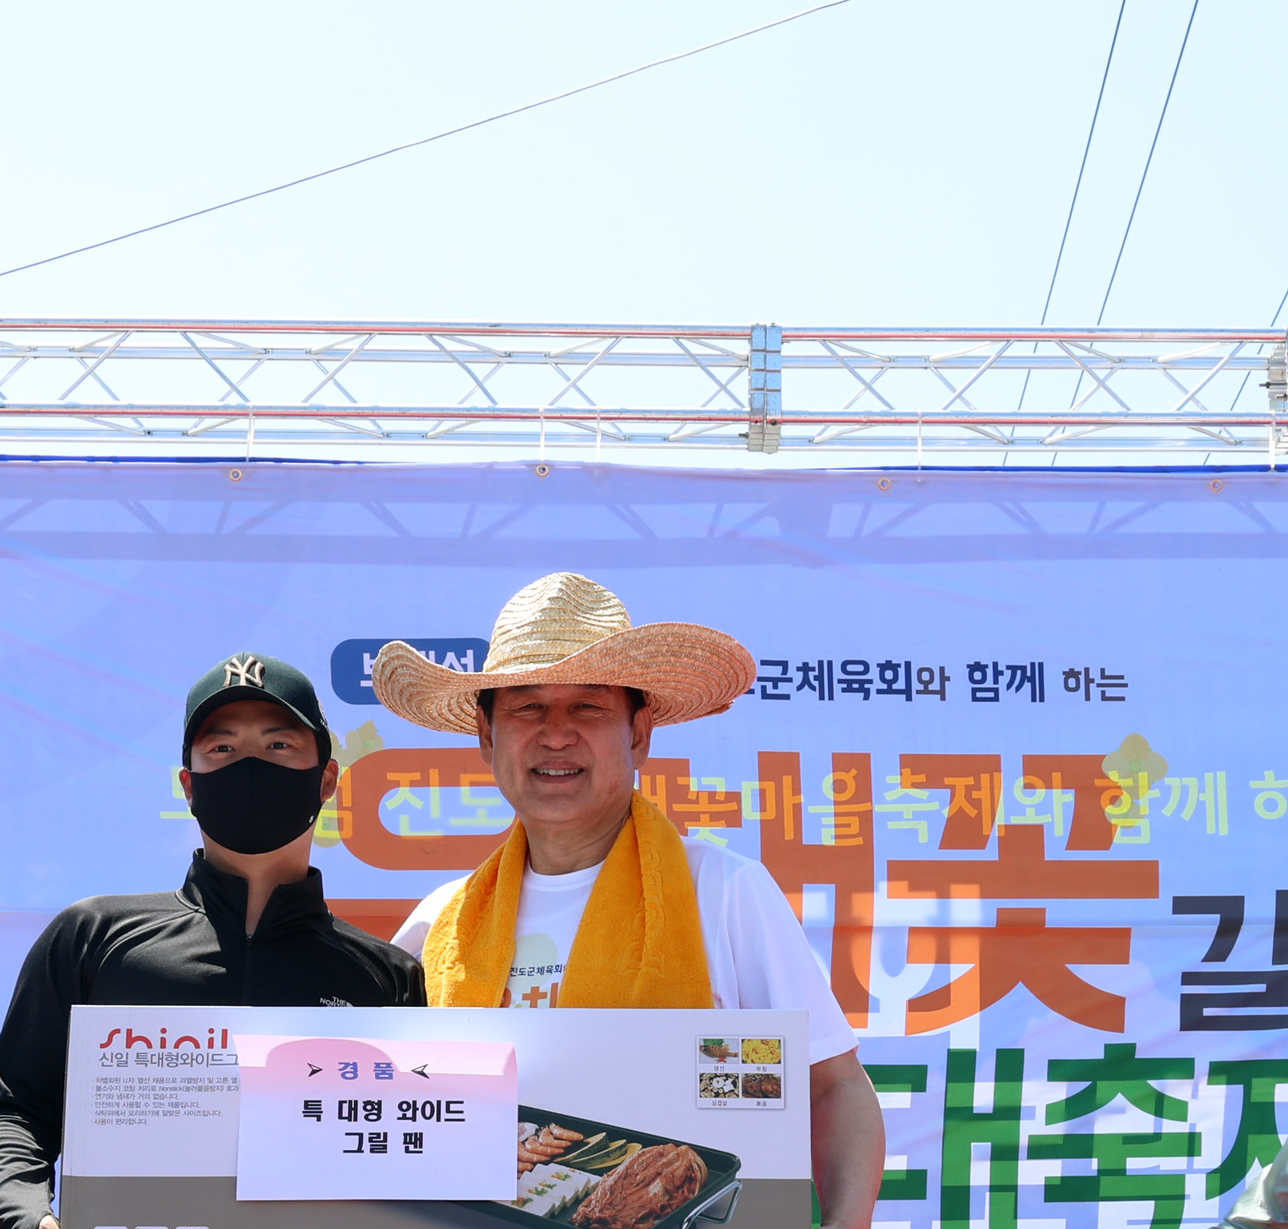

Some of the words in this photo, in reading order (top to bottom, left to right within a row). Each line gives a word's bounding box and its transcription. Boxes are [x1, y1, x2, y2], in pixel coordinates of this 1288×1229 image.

[745, 659, 950, 701] 군체육회와
[966, 661, 1044, 702] 함께
[1063, 667, 1128, 701] 하는
[385, 768, 518, 839] 진도
[1093, 772, 1229, 845] 함께
[99, 1027, 228, 1049] Shinil
[99, 1052, 129, 1067] 신일
[337, 1060, 362, 1082] 경
[373, 1061, 396, 1082] 품
[302, 1098, 324, 1123] 특
[337, 1098, 385, 1124] 대형
[395, 1098, 467, 1123] 와이드
[342, 1130, 389, 1155] 그릴
[402, 1130, 426, 1155] 팬
